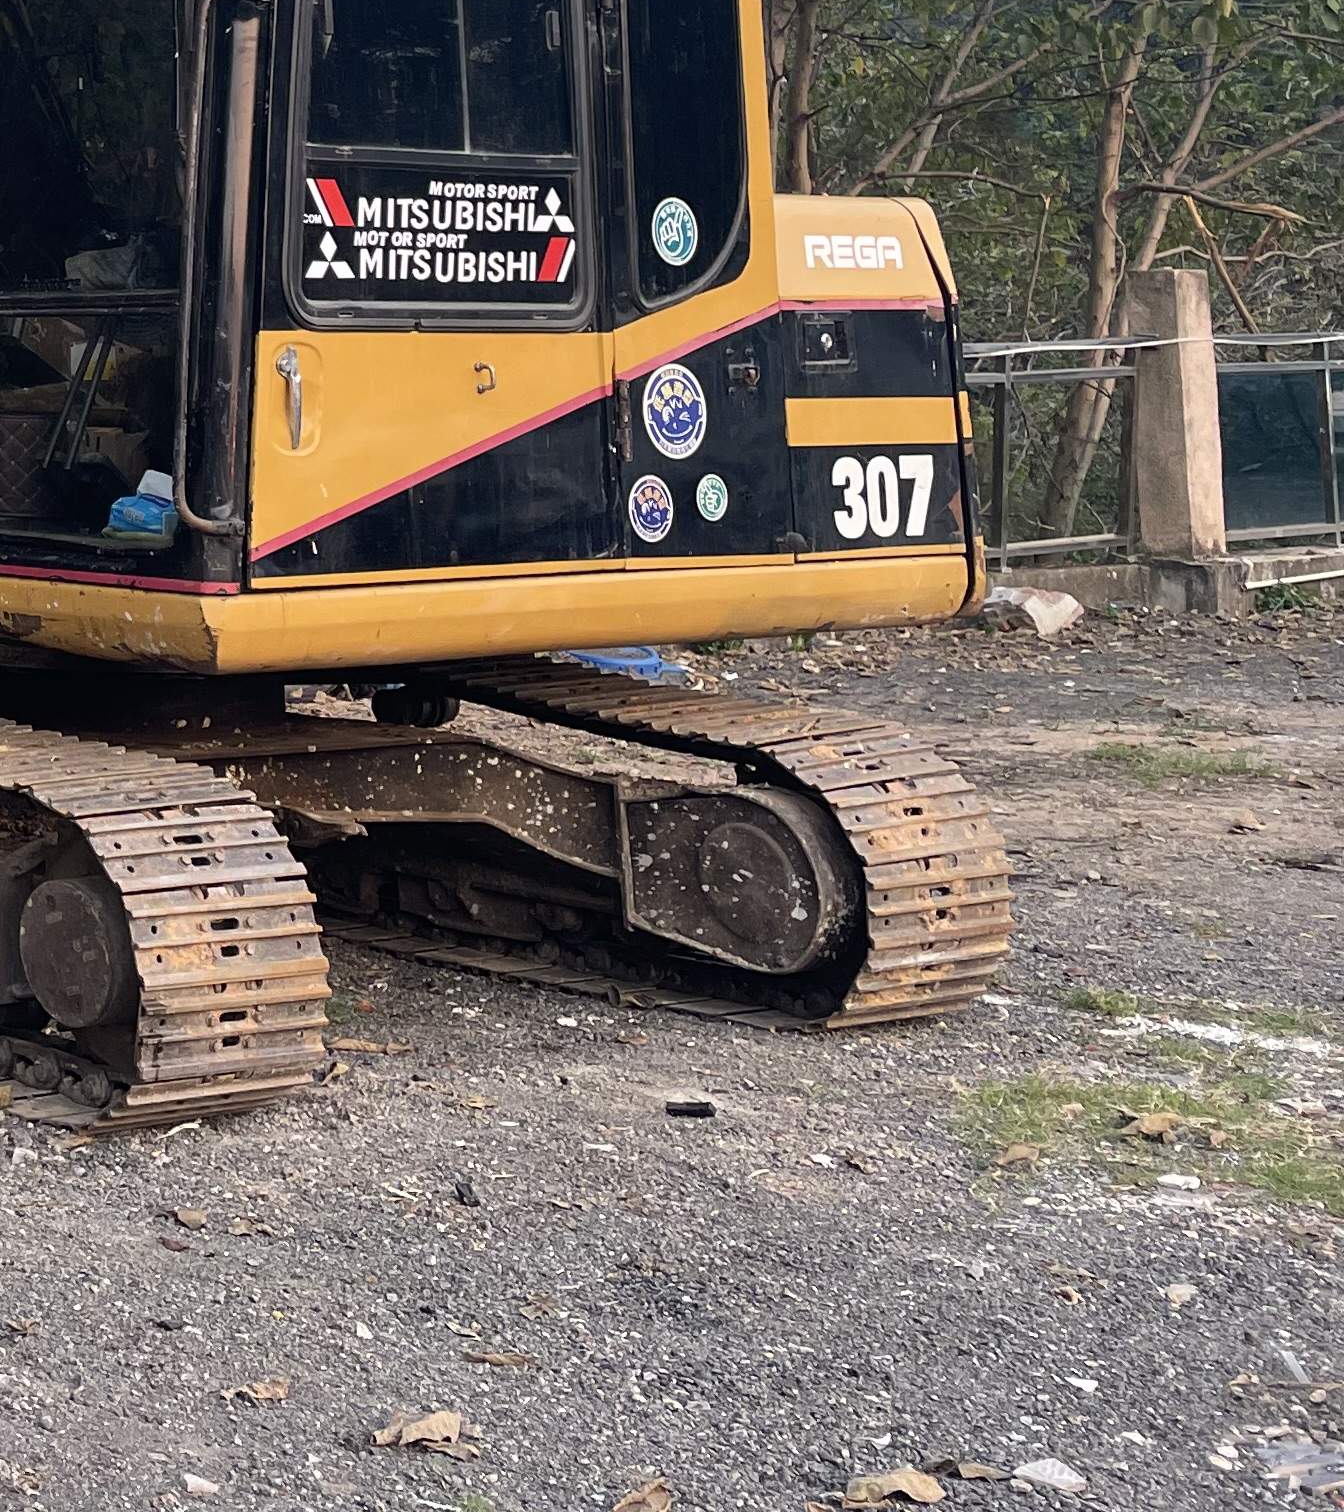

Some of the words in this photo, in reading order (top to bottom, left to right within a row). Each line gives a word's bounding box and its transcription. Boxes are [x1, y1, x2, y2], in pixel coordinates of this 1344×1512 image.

[357, 197, 535, 232] MITSUBISHI
[359, 248, 536, 282] MITSUBISHI
[803, 234, 904, 270] REGA
[832, 454, 934, 540] 307
